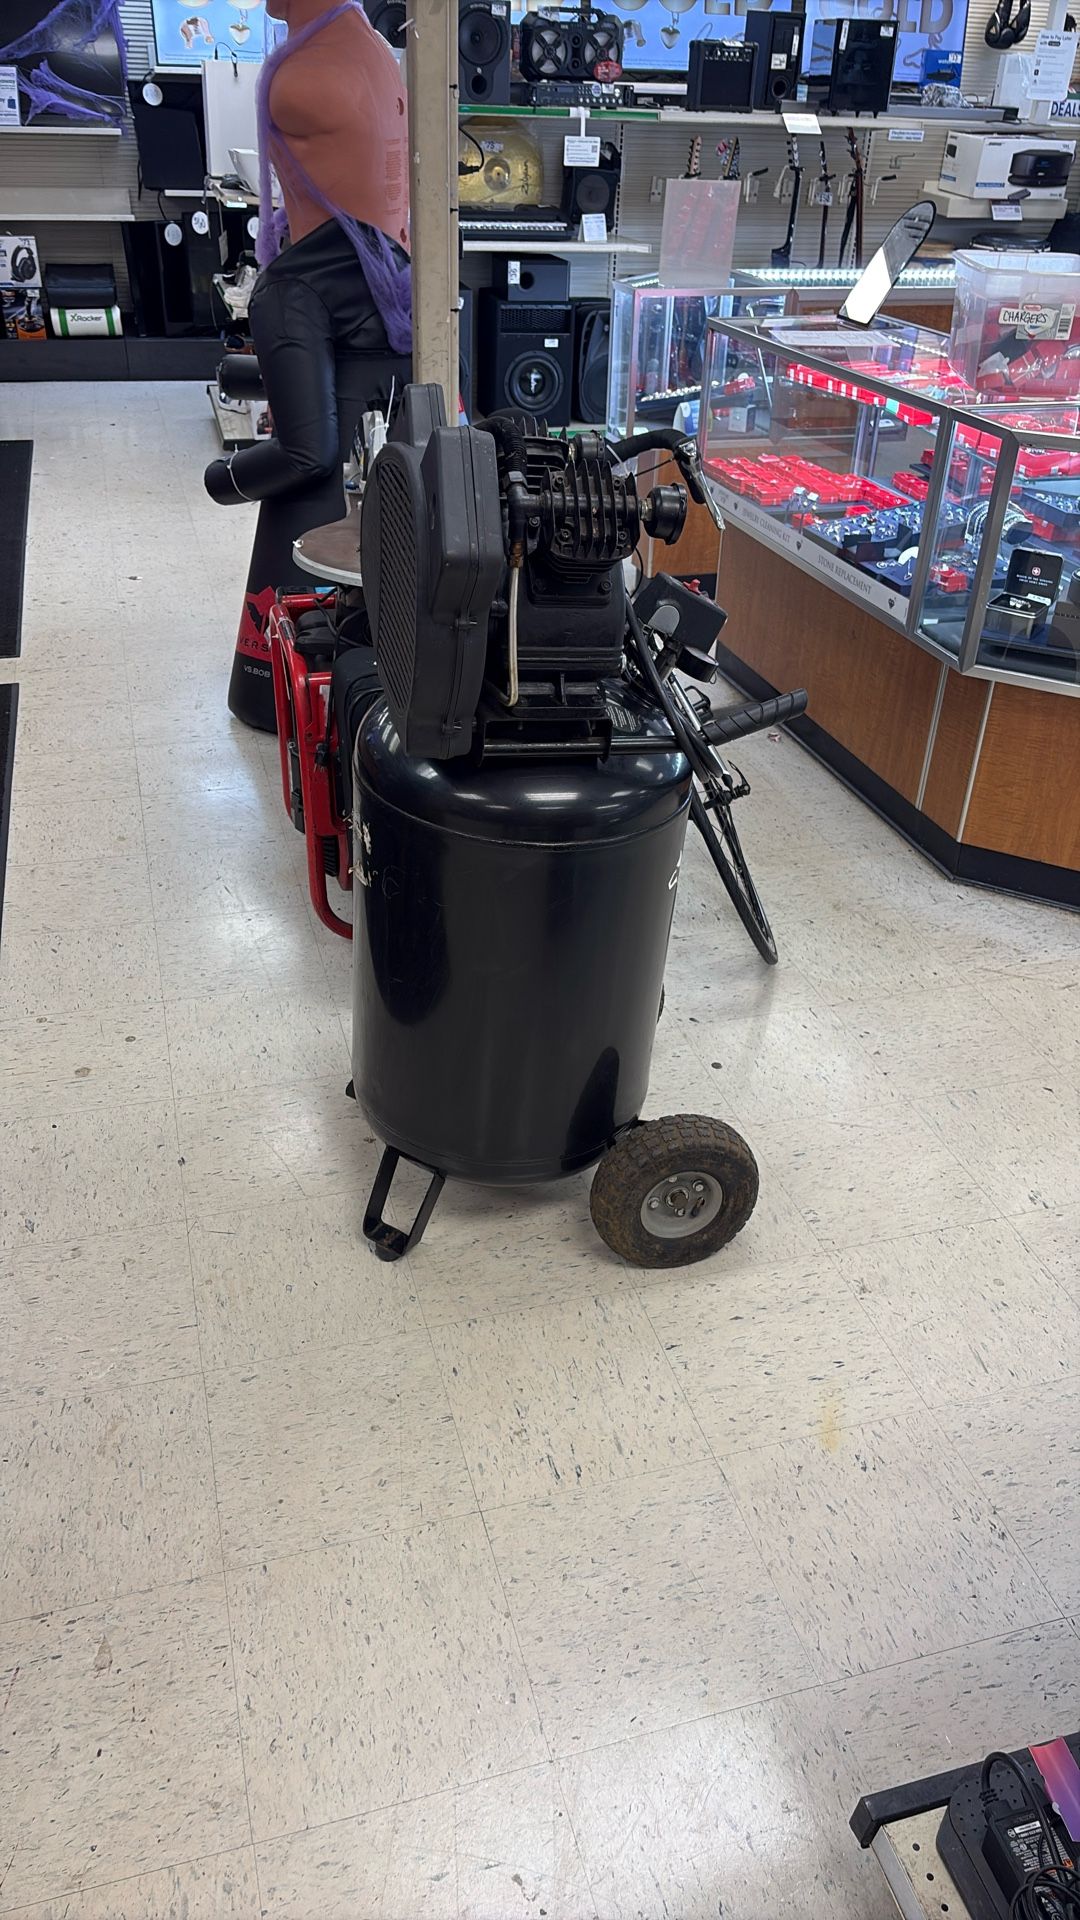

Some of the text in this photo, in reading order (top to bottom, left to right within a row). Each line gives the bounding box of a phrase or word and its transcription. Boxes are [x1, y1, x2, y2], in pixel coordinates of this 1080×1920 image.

[1002, 310, 1048, 324] CHARGERS
[760, 518, 782, 539] CLEANING
[782, 531, 791, 543] KIT
[818, 554, 872, 595] STONE REPLACEMENT
[244, 665, 271, 678] VS.BOB
